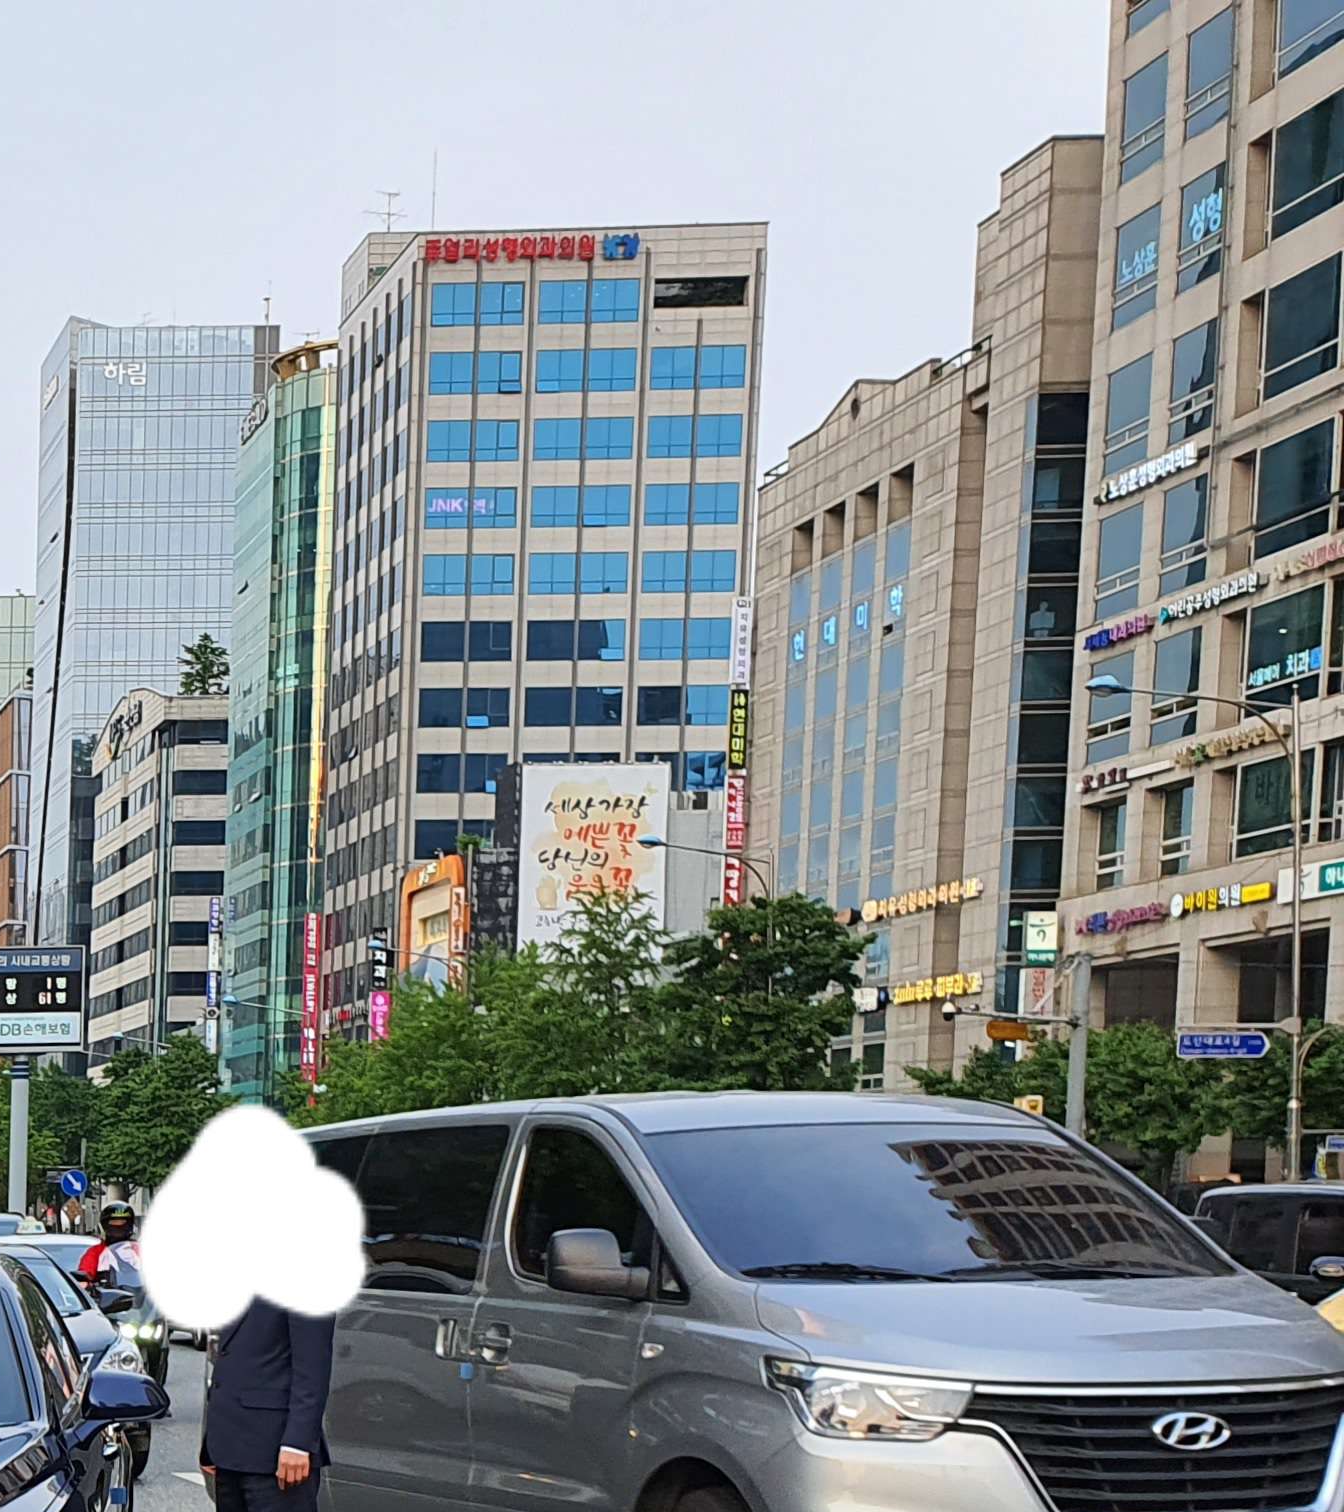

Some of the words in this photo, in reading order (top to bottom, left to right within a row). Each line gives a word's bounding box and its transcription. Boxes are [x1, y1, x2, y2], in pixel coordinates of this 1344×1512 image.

[104, 362, 147, 386] 하림
[1286, 648, 1310, 677] 치과
[563, 821, 612, 850] 예쁜
[613, 821, 637, 859] 꽃
[538, 847, 609, 872] 당신의
[10, 955, 71, 967] 시내교통상황
[0, 1022, 71, 1037] DB손해보험
